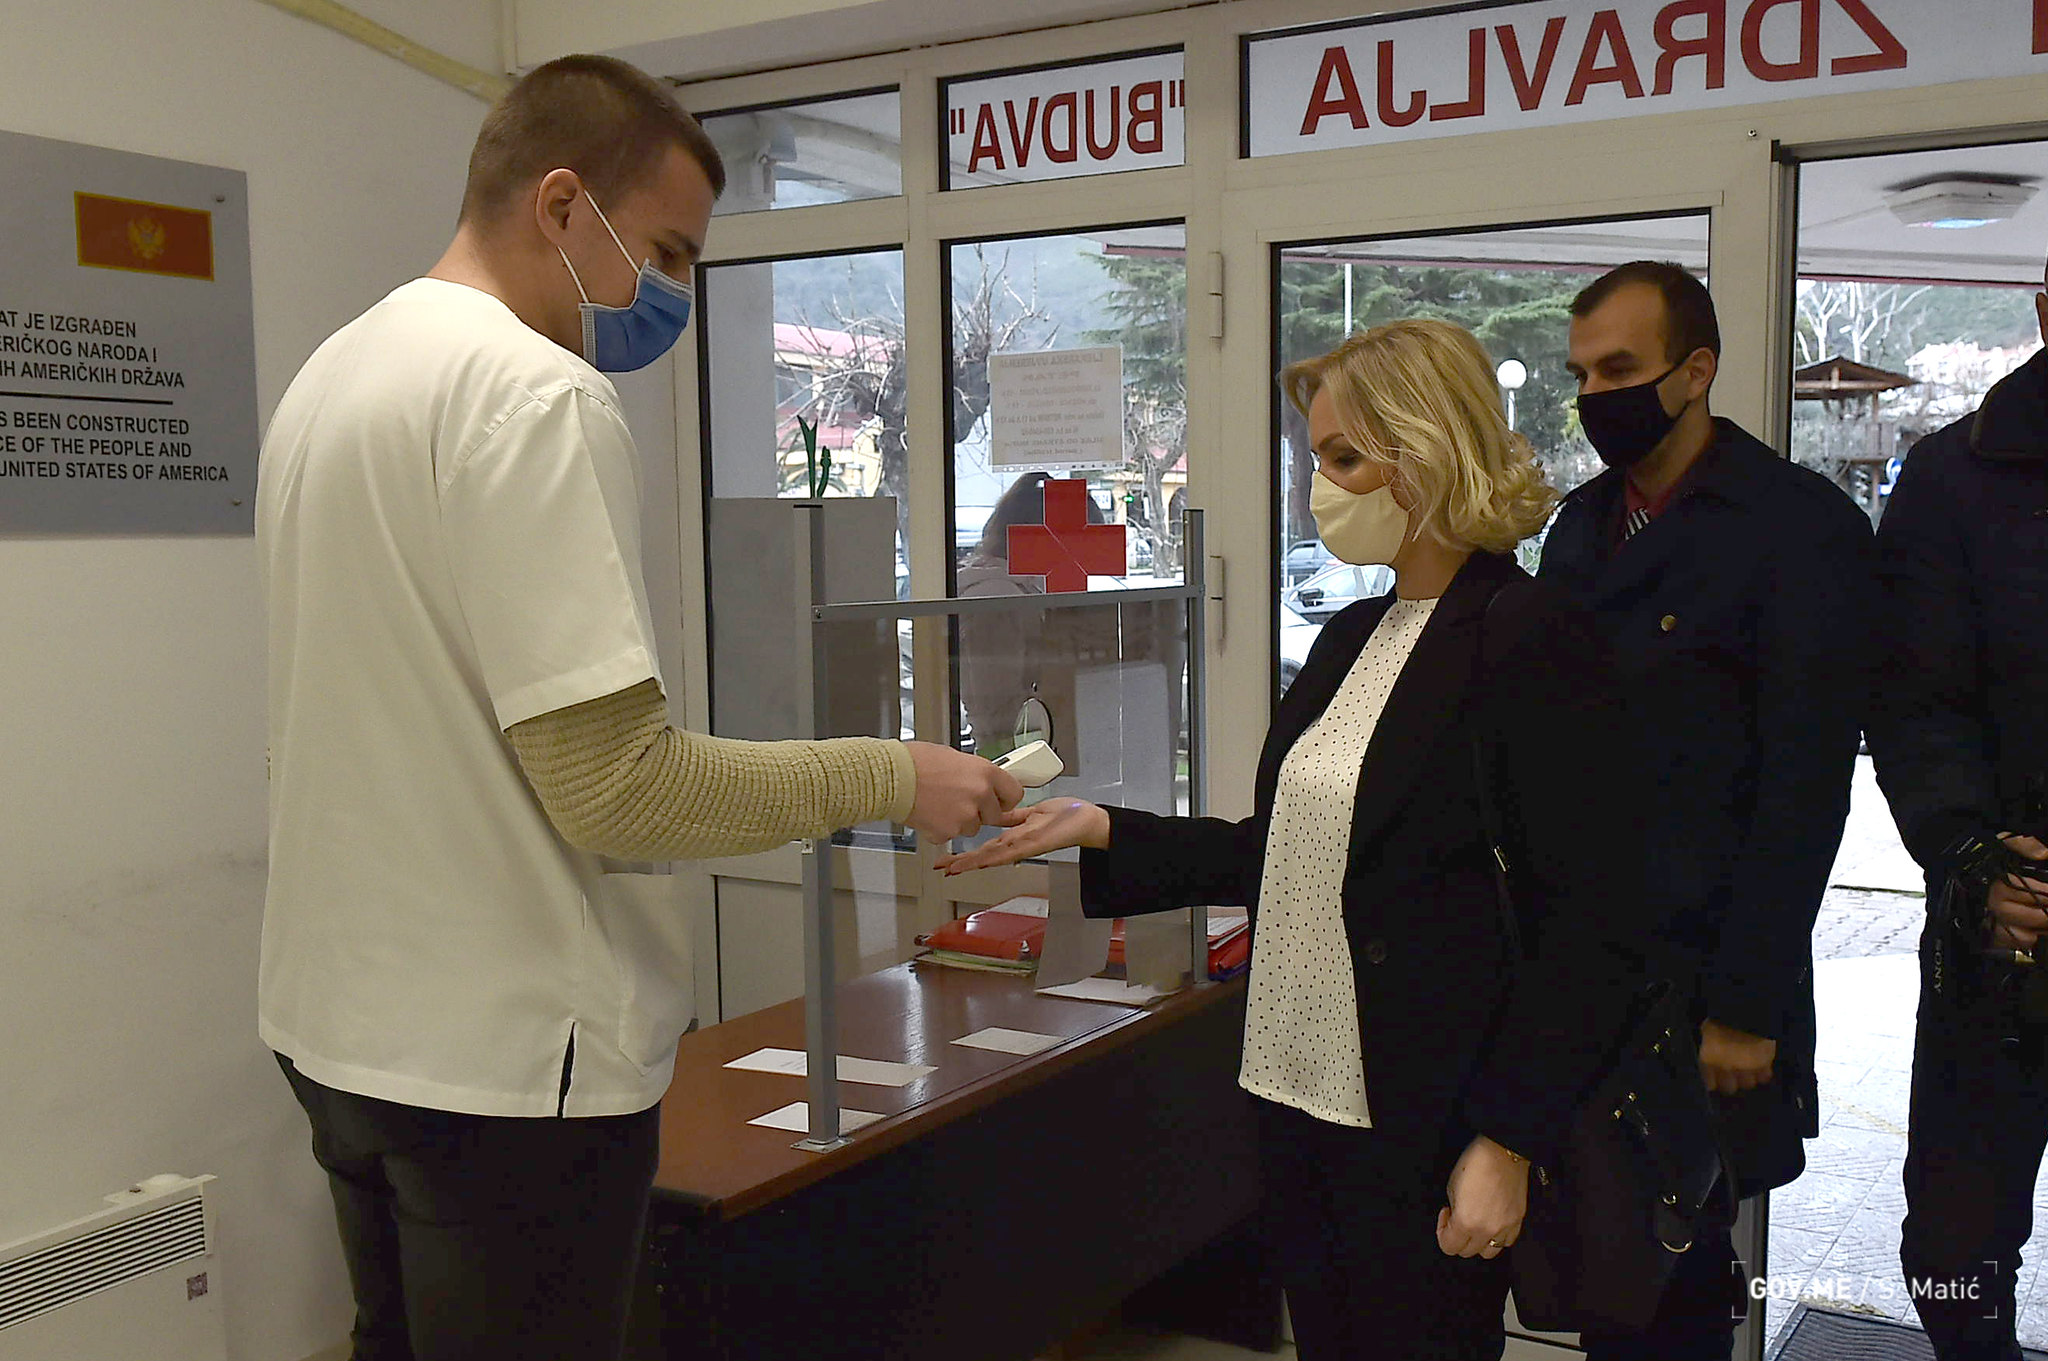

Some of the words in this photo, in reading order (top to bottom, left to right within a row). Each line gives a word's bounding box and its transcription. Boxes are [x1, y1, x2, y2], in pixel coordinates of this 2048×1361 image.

[24, 312, 45, 330] JE
[50, 315, 136, 338] IZGRAĐEN
[0, 333, 72, 357] RIČKOG
[78, 341, 149, 363] NARODA
[153, 347, 157, 363] I
[21, 361, 116, 384] AMERIČKIH
[122, 366, 185, 388] DRŽAVA
[14, 411, 61, 429] BEEN
[67, 414, 189, 435] CONSTRUCTED
[22, 436, 45, 453] OF
[51, 437, 84, 454] THE
[89, 438, 154, 457] PEOPLE
[159, 442, 191, 458] AND
[66, 462, 128, 479] STATES
[133, 464, 153, 480] OF
[159, 464, 229, 482] AMERICA
